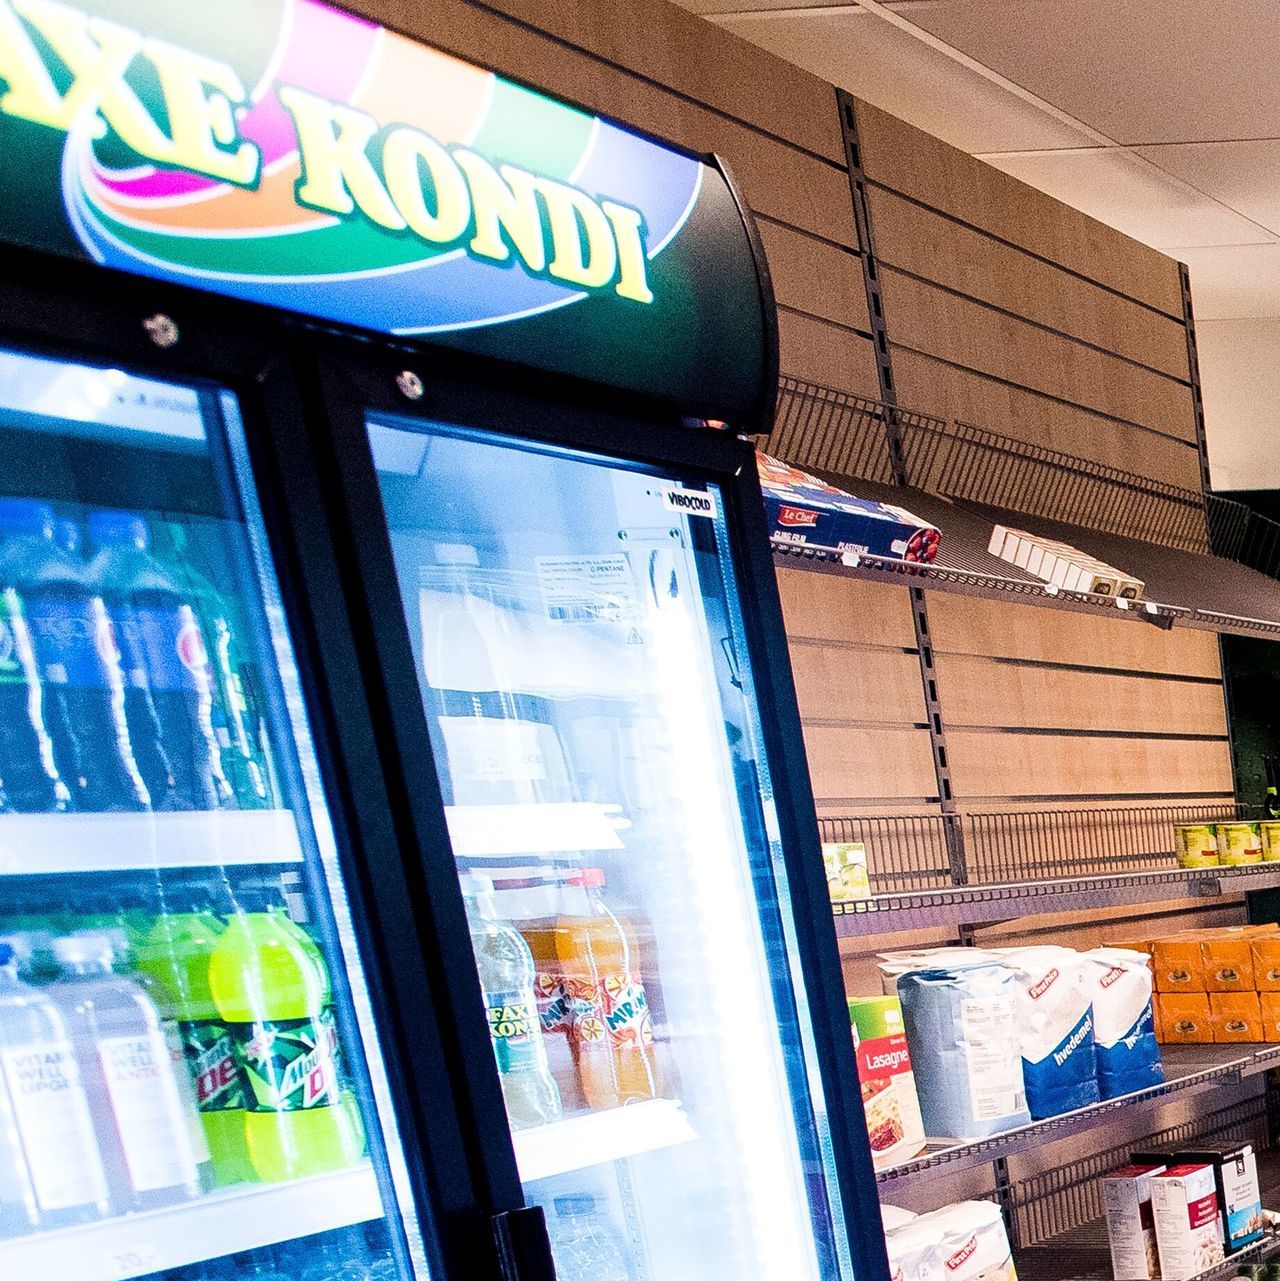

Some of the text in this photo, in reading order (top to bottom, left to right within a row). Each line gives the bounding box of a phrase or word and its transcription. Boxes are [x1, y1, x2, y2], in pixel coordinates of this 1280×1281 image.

[280, 86, 655, 303] KONDI
[866, 1049, 909, 1071] Lasagne
[1053, 1015, 1093, 1066] hvedemel
